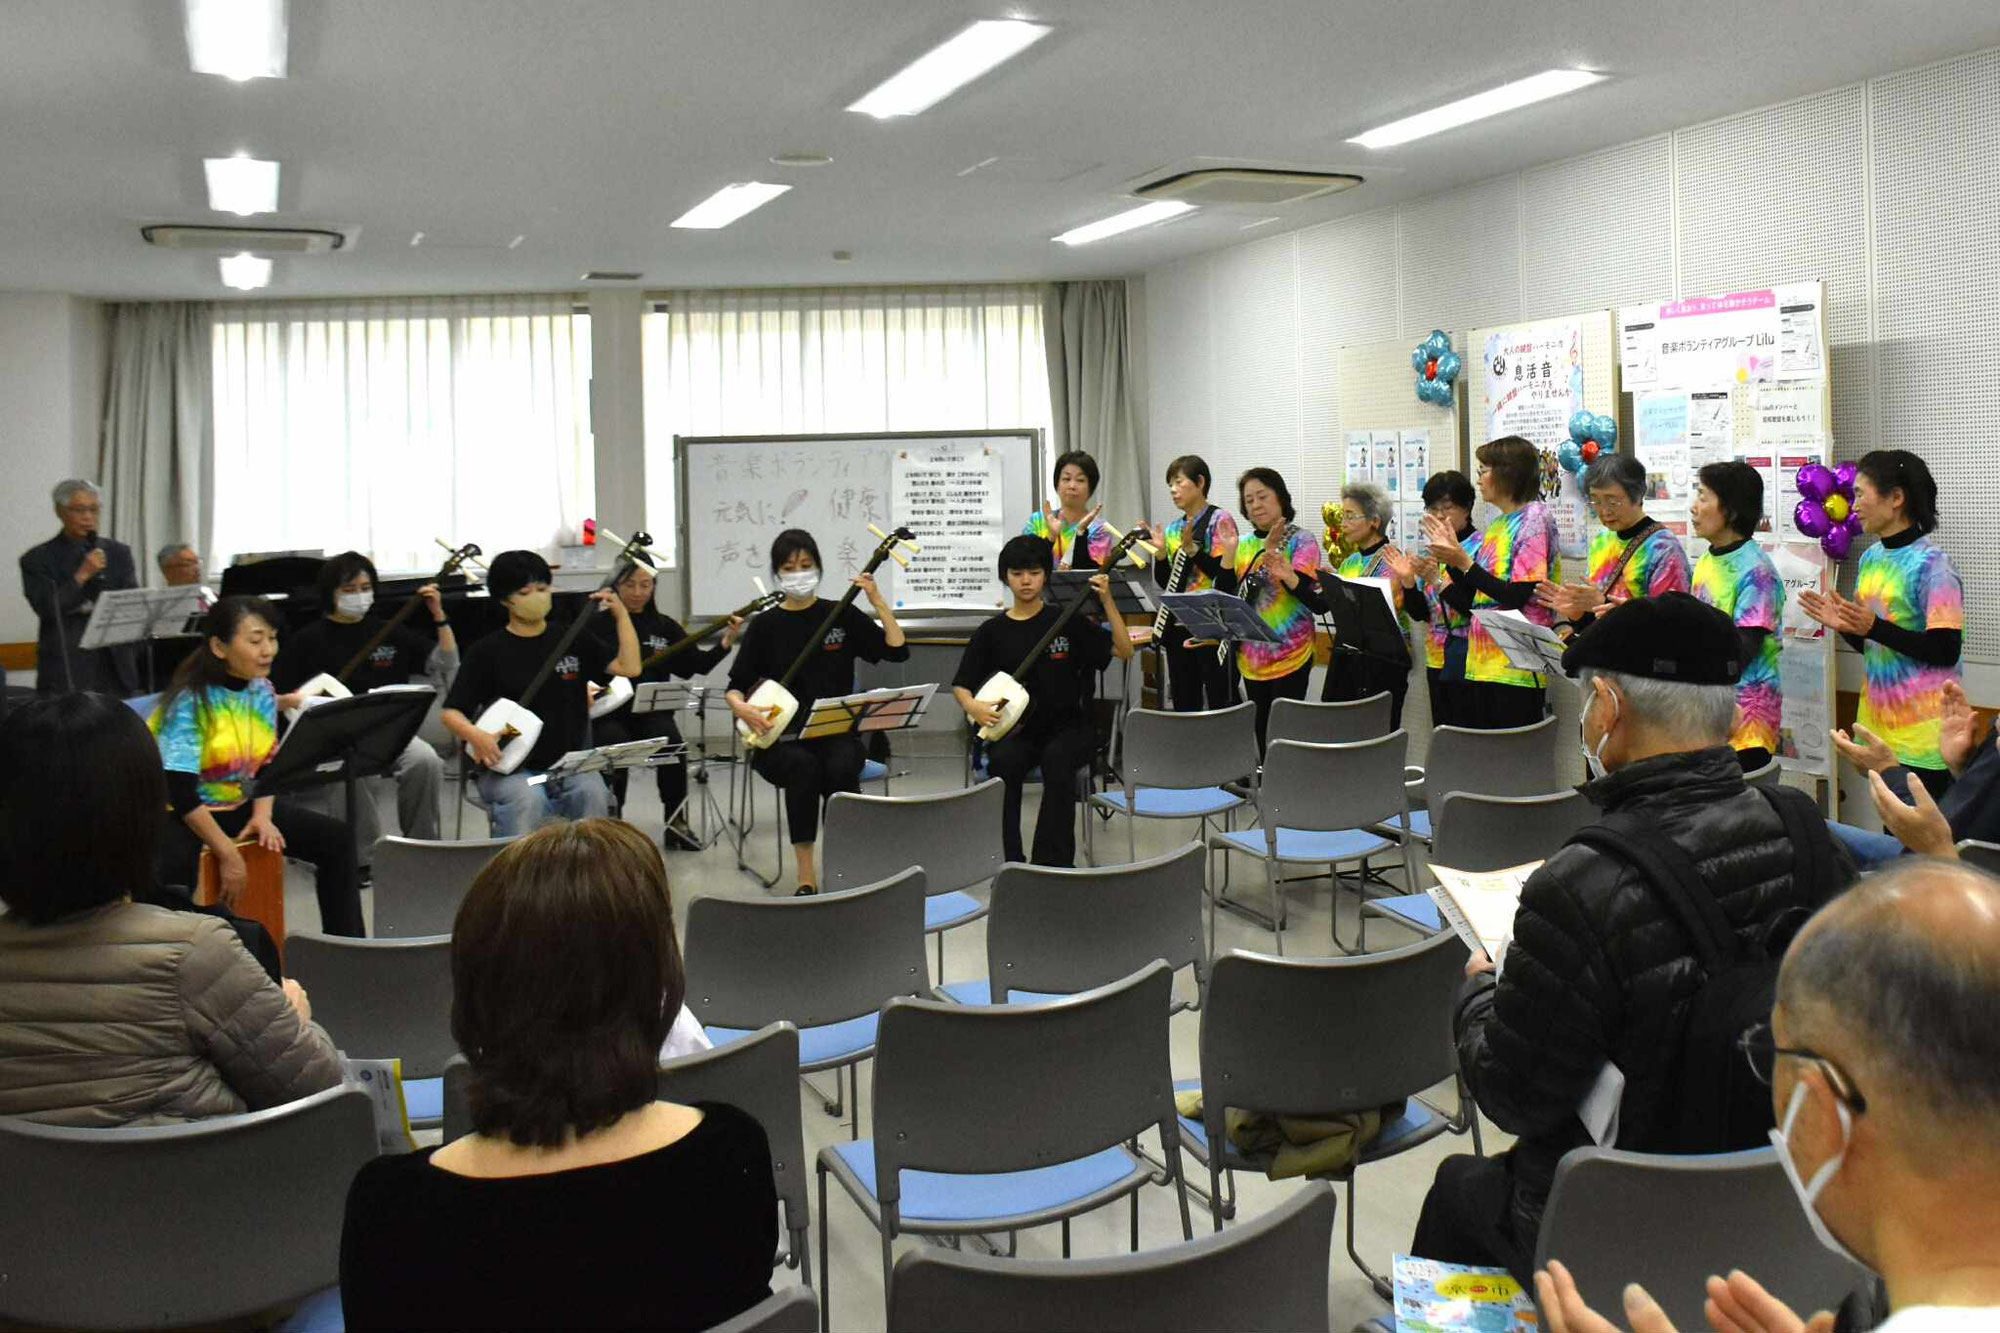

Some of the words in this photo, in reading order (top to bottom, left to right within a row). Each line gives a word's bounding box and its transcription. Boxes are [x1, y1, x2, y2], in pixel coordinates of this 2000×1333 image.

[1662, 335, 1754, 354] 音楽ボランティアグループ
[1756, 332, 1775, 346] Lilu
[1514, 361, 1552, 381] 息活音
[1531, 387, 1572, 399] やりませんか
